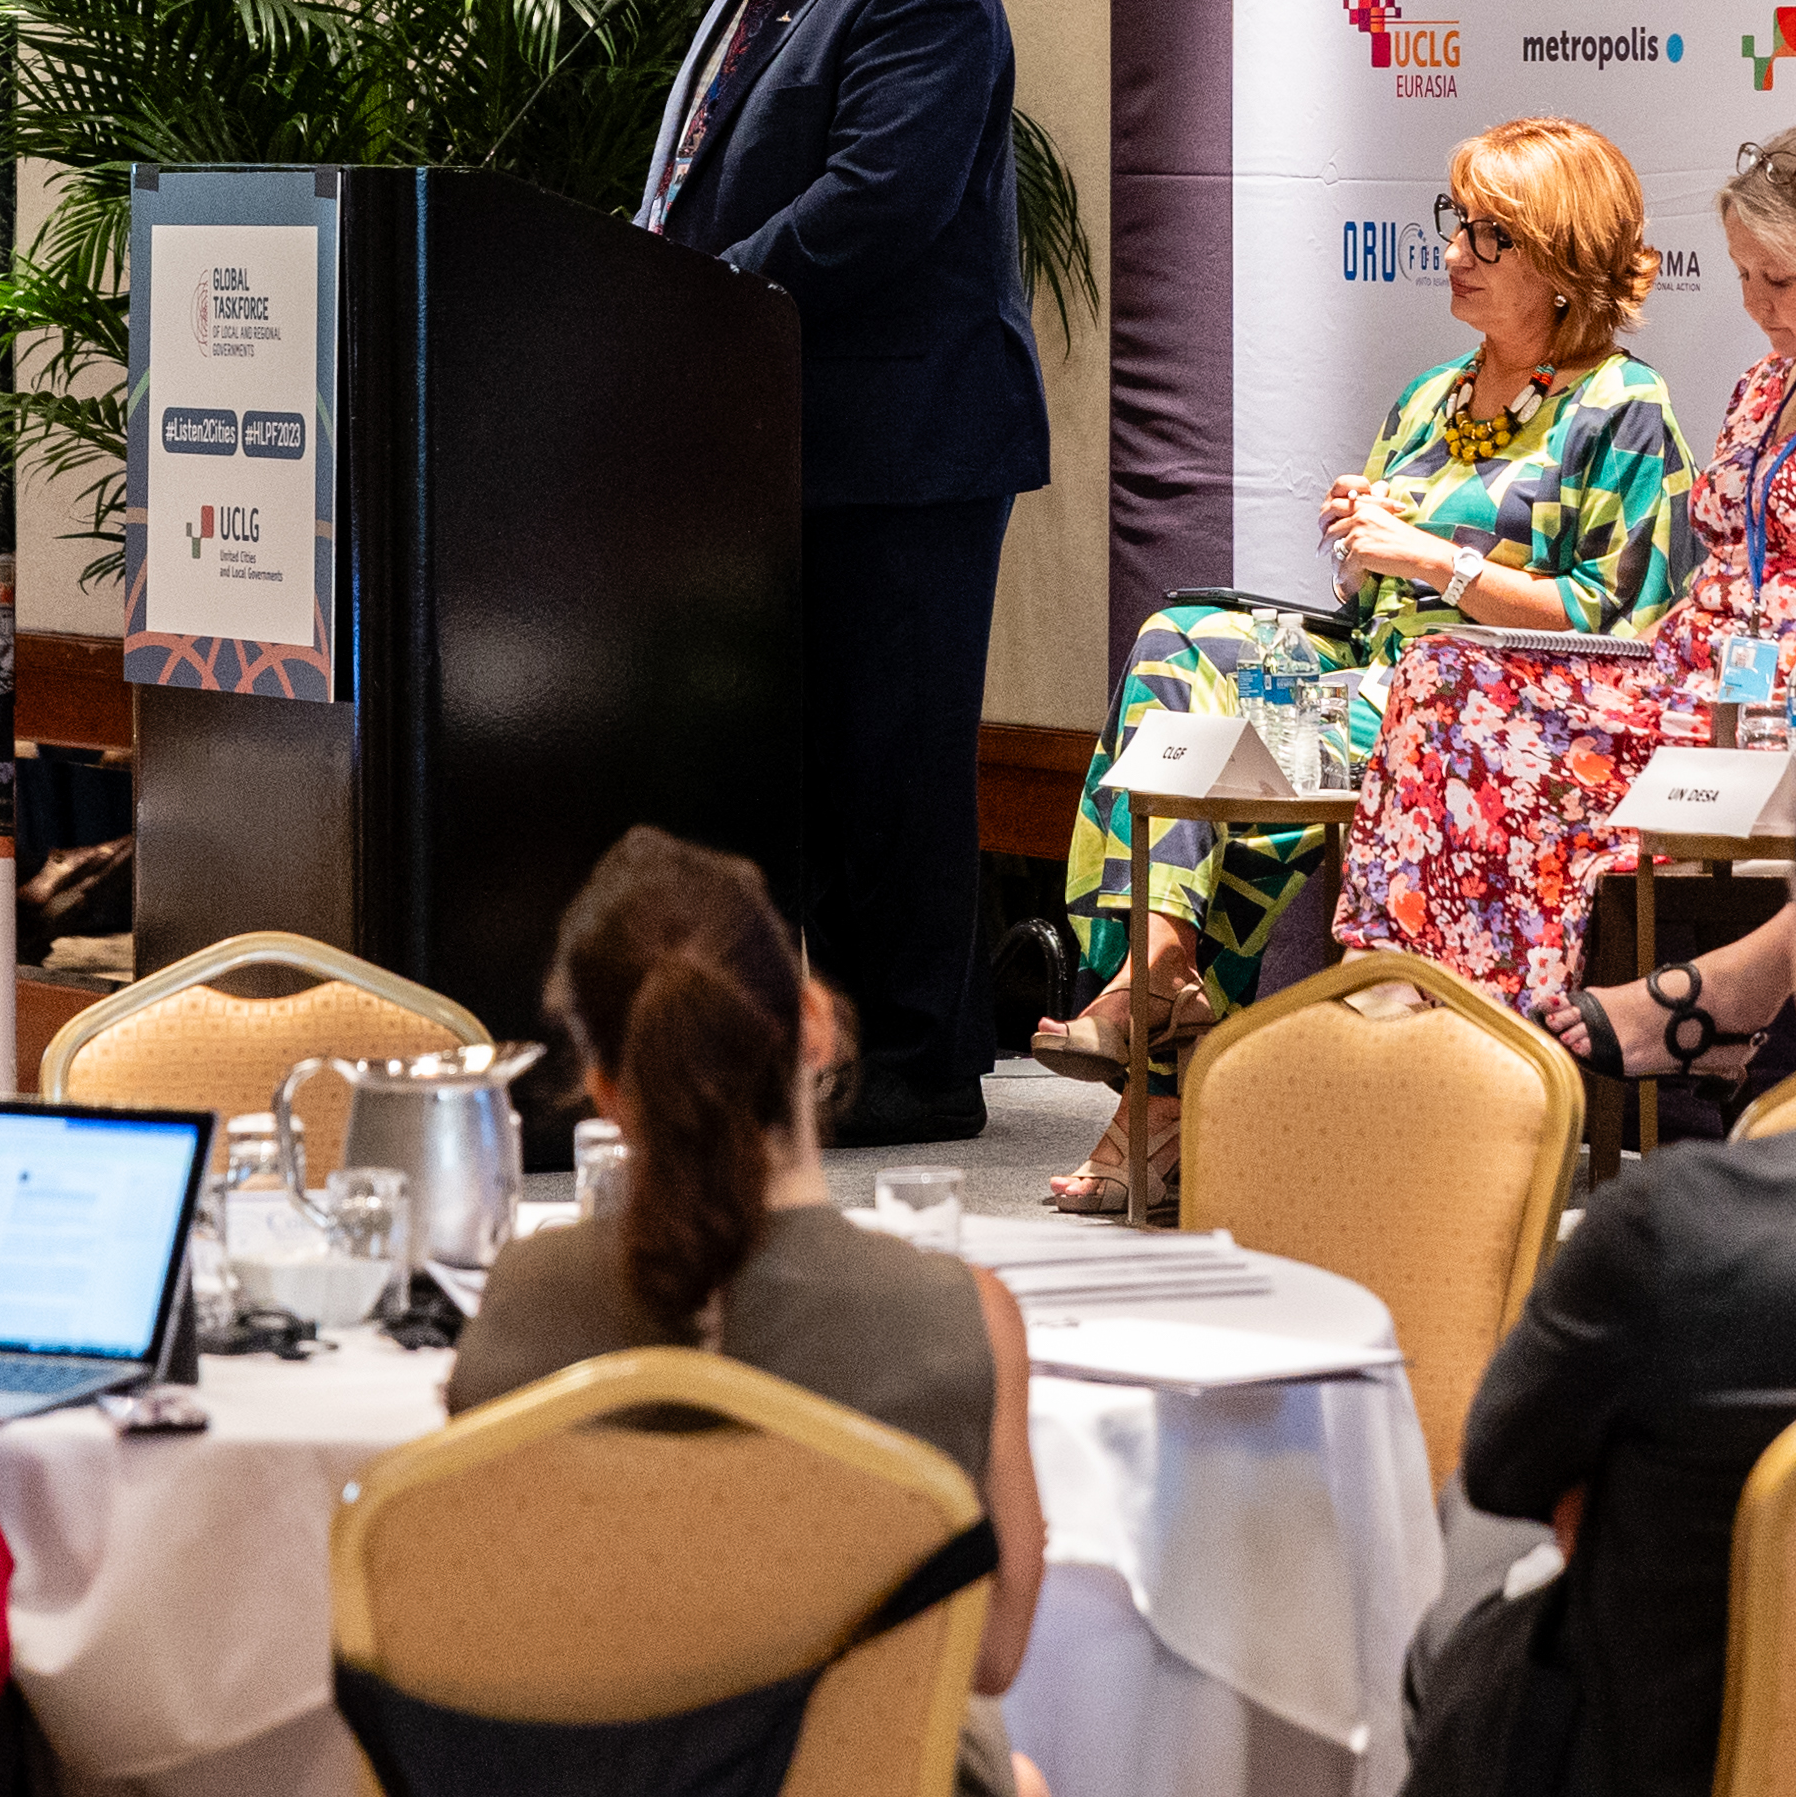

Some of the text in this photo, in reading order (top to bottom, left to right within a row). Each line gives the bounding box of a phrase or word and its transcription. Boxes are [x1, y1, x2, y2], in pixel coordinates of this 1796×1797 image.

[1394, 30, 1460, 68] UCLG
[1523, 27, 1659, 70] metropolis
[1396, 75, 1458, 98] EURASIA
[1344, 221, 1448, 282] ORU FOG
[213, 267, 250, 291] GLOBAL
[1676, 282, 1700, 292] ACTION
[213, 296, 269, 320] TASKFORCE
[165, 417, 236, 445] #Listen2Cities
[244, 421, 301, 449] #HLPF2023
[220, 506, 259, 543] UCLG
